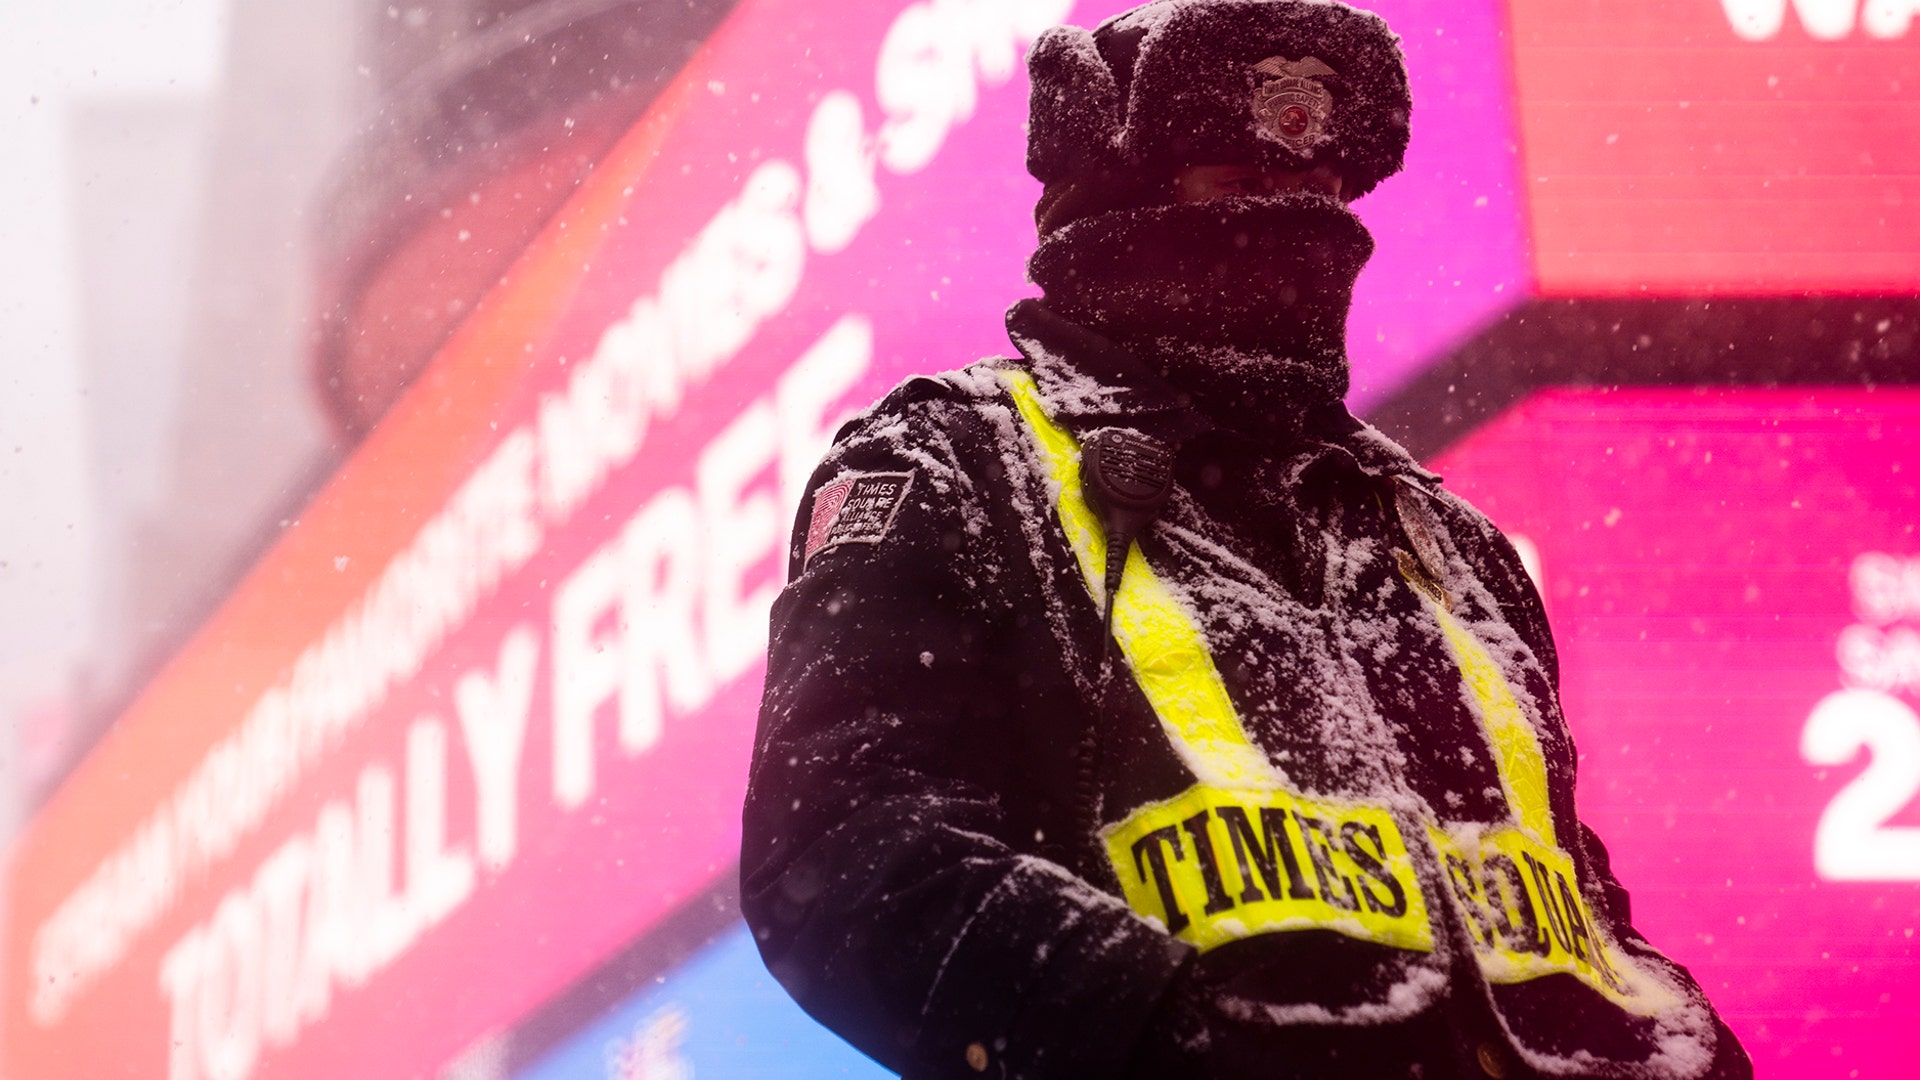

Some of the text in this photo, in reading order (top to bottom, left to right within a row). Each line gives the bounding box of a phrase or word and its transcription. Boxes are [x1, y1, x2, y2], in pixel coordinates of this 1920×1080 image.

[856, 482, 897, 496] TIMES
[158, 628, 540, 1080] TOTALLY
[548, 312, 872, 810] FREE
[1131, 804, 1624, 990] TIMES SQUA
